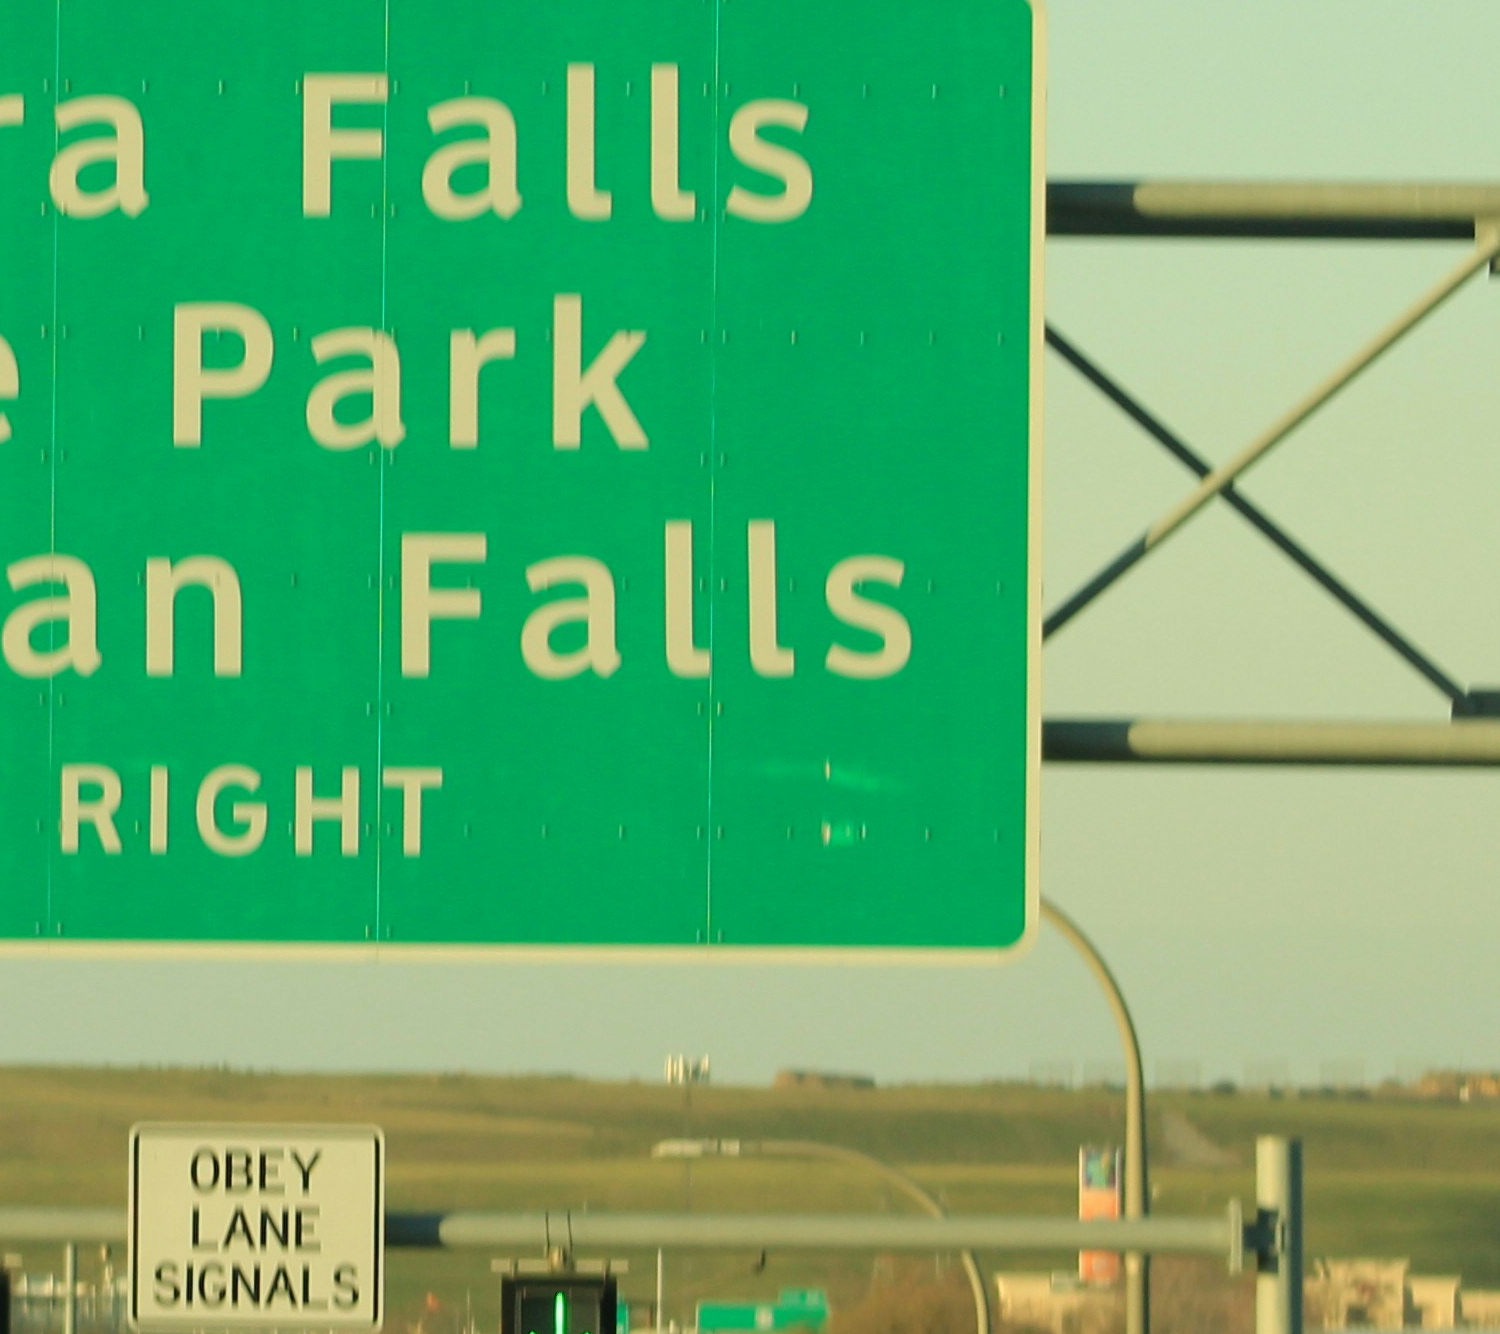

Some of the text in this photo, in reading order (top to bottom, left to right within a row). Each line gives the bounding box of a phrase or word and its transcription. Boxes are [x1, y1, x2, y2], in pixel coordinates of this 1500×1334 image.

[300, 63, 818, 224] Falls
[171, 293, 651, 450] Park
[400, 519, 915, 680] Falls
[59, 765, 443, 858] RIGHT
[189, 1147, 323, 1196] OBEY
[190, 1204, 322, 1254] LANE
[152, 1263, 361, 1314] SIGNALS
